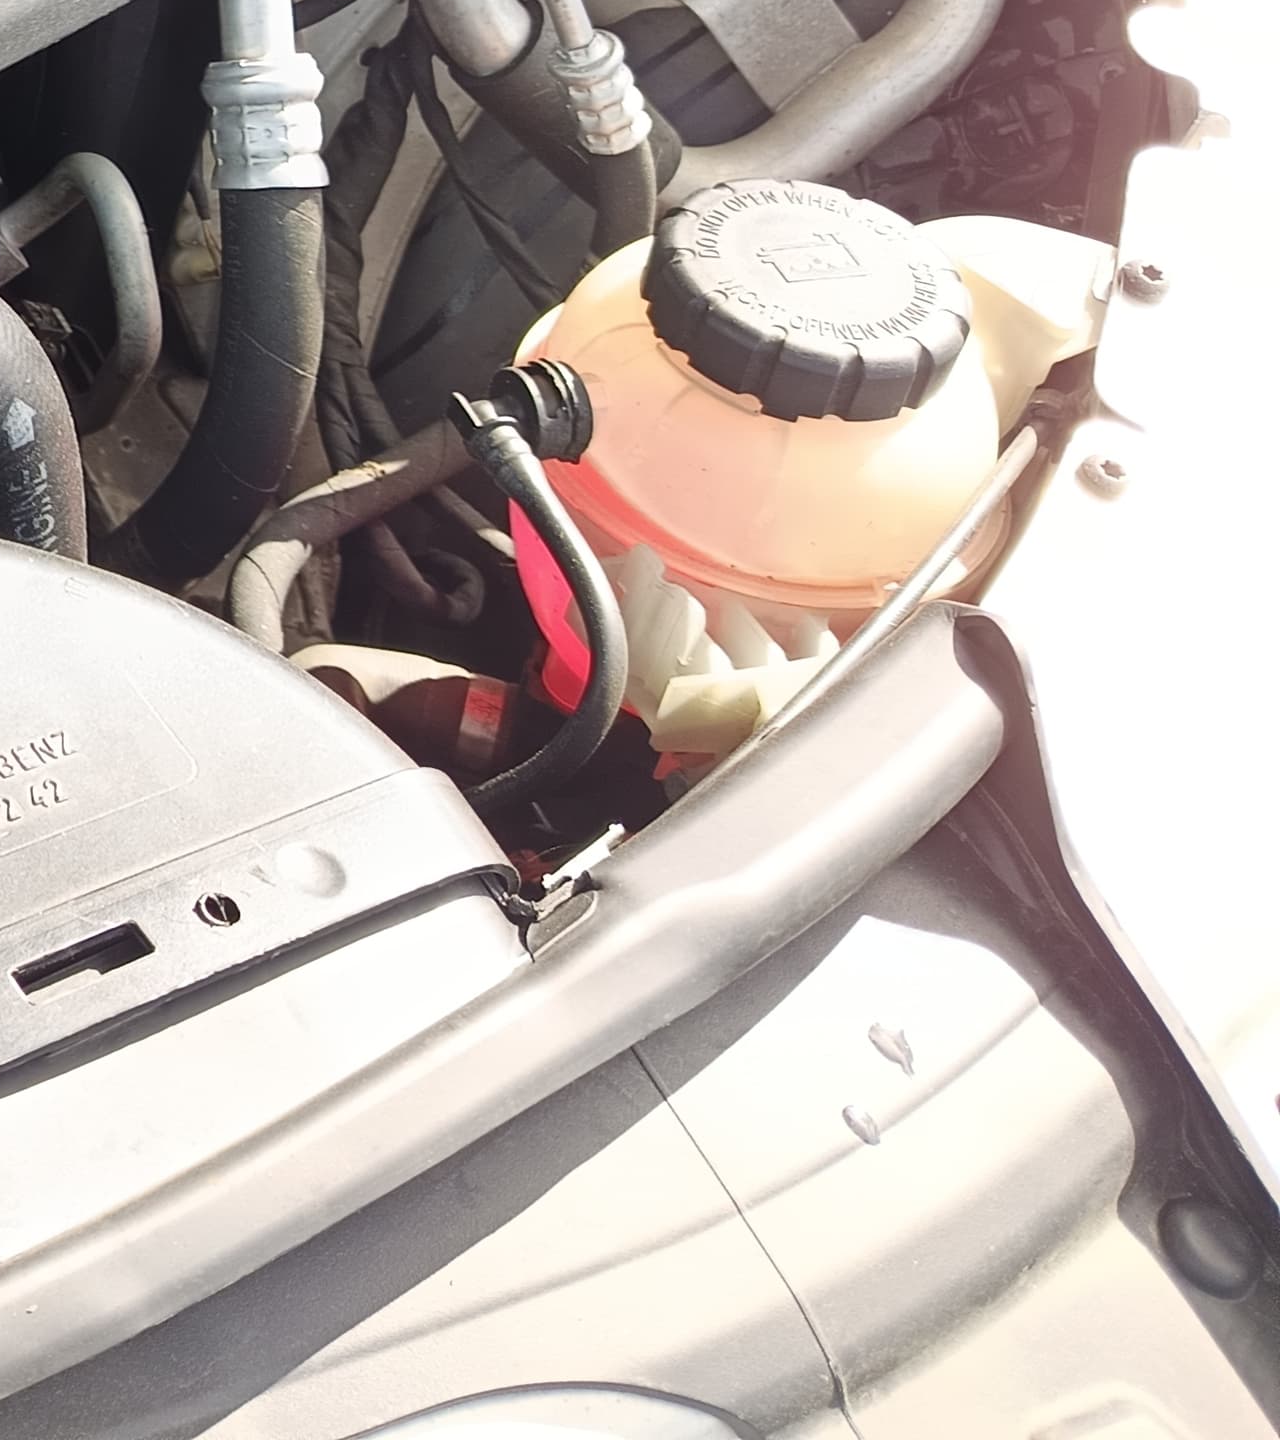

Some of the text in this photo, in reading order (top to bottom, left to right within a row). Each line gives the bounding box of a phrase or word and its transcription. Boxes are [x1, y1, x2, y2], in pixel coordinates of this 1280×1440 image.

[695, 238, 721, 260] DO
[724, 189, 780, 213] OPEN
[784, 189, 852, 219] WHEN
[29, 778, 69, 810] 42
